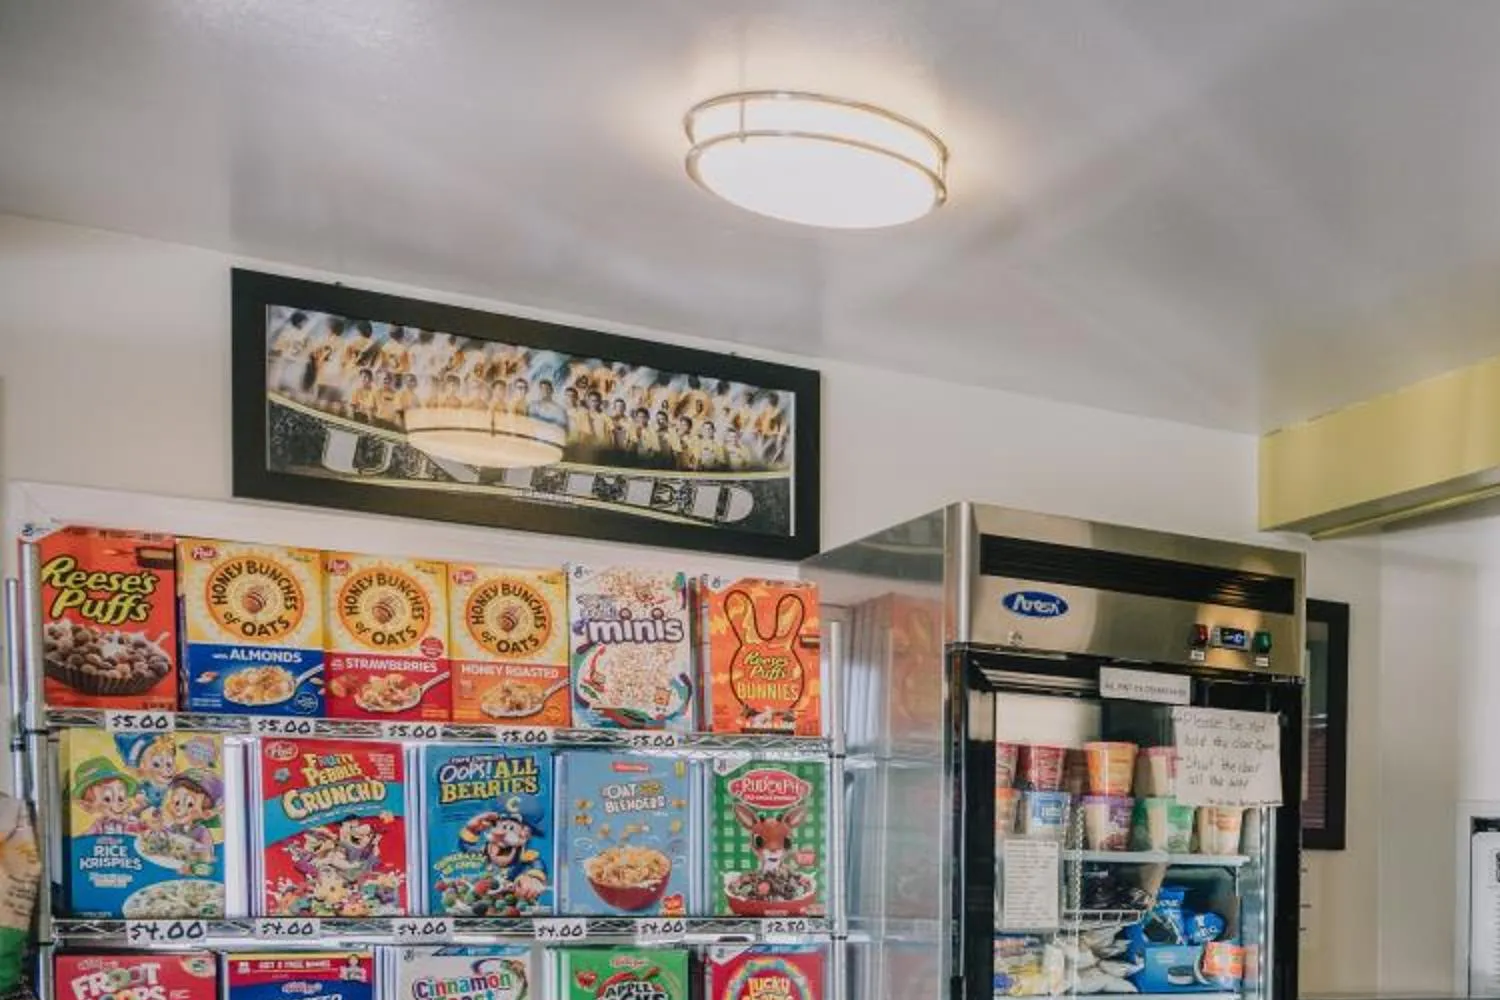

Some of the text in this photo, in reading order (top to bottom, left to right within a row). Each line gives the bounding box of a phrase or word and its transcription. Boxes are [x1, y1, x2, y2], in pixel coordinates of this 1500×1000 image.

[41, 555, 159, 596] Reese's
[211, 560, 298, 611] HONEY BUNCHES
[345, 572, 424, 621] HONEY BUNCHES
[471, 585, 499, 625] HONEY
[501, 583, 547, 629] BUNCHES
[49, 590, 151, 625] Puffs
[241, 615, 290, 637] OATS
[587, 607, 685, 645] minis
[372, 627, 417, 646] OATS
[496, 634, 540, 653] OATS
[230, 649, 302, 664] ALMONDS
[345, 657, 437, 673] STRAWBERRIES
[505, 665, 559, 679] ROASTED
[111, 713, 170, 730] $5.00
[257, 719, 312, 735] $5.00
[388, 724, 437, 739] $5.00
[494, 757, 537, 780] ALL
[442, 775, 538, 803] BERRIES
[93, 845, 129, 858] RICE
[79, 857, 143, 872] KRISPIES
[131, 922, 203, 941] $4.00
[262, 922, 313, 937] $4.00
[398, 920, 447, 936] $4.00
[71, 962, 161, 1000] FROOT
[414, 972, 512, 1000] Cinnamon
[605, 983, 653, 998] APPLE
